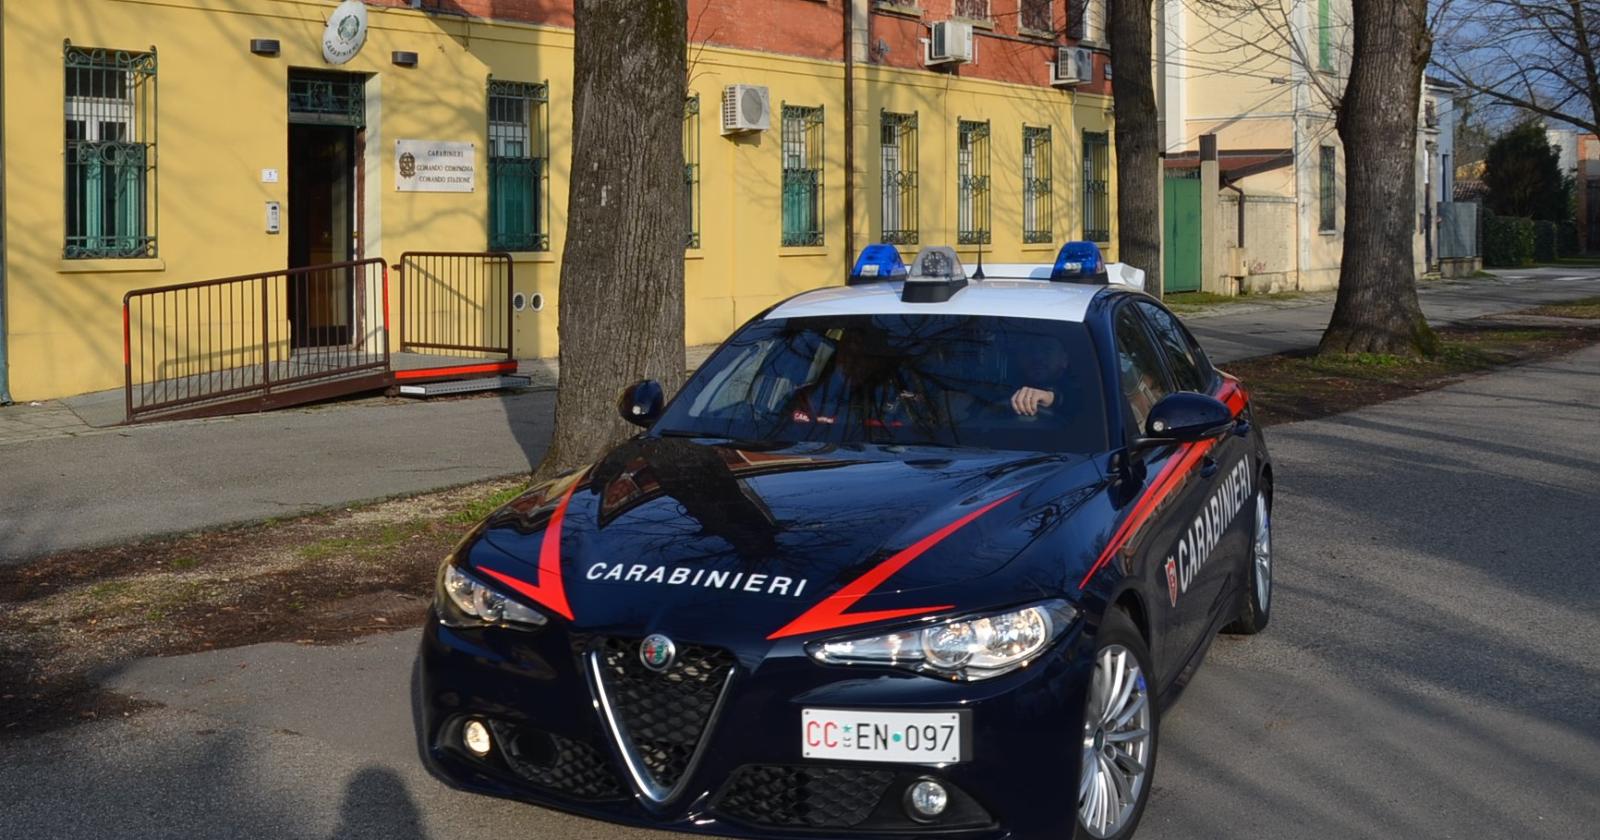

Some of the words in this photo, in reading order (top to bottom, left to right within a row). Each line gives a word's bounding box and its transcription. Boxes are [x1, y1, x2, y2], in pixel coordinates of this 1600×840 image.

[427, 150, 464, 158] CARABINIERI
[416, 164, 444, 172] COMANDO
[418, 175, 446, 183] COMANDO
[1178, 454, 1252, 594] CARABINIERI
[586, 562, 807, 598] CARABINIERI
[807, 720, 838, 748] CC
[856, 723, 888, 750] EN
[905, 724, 955, 752] 097
